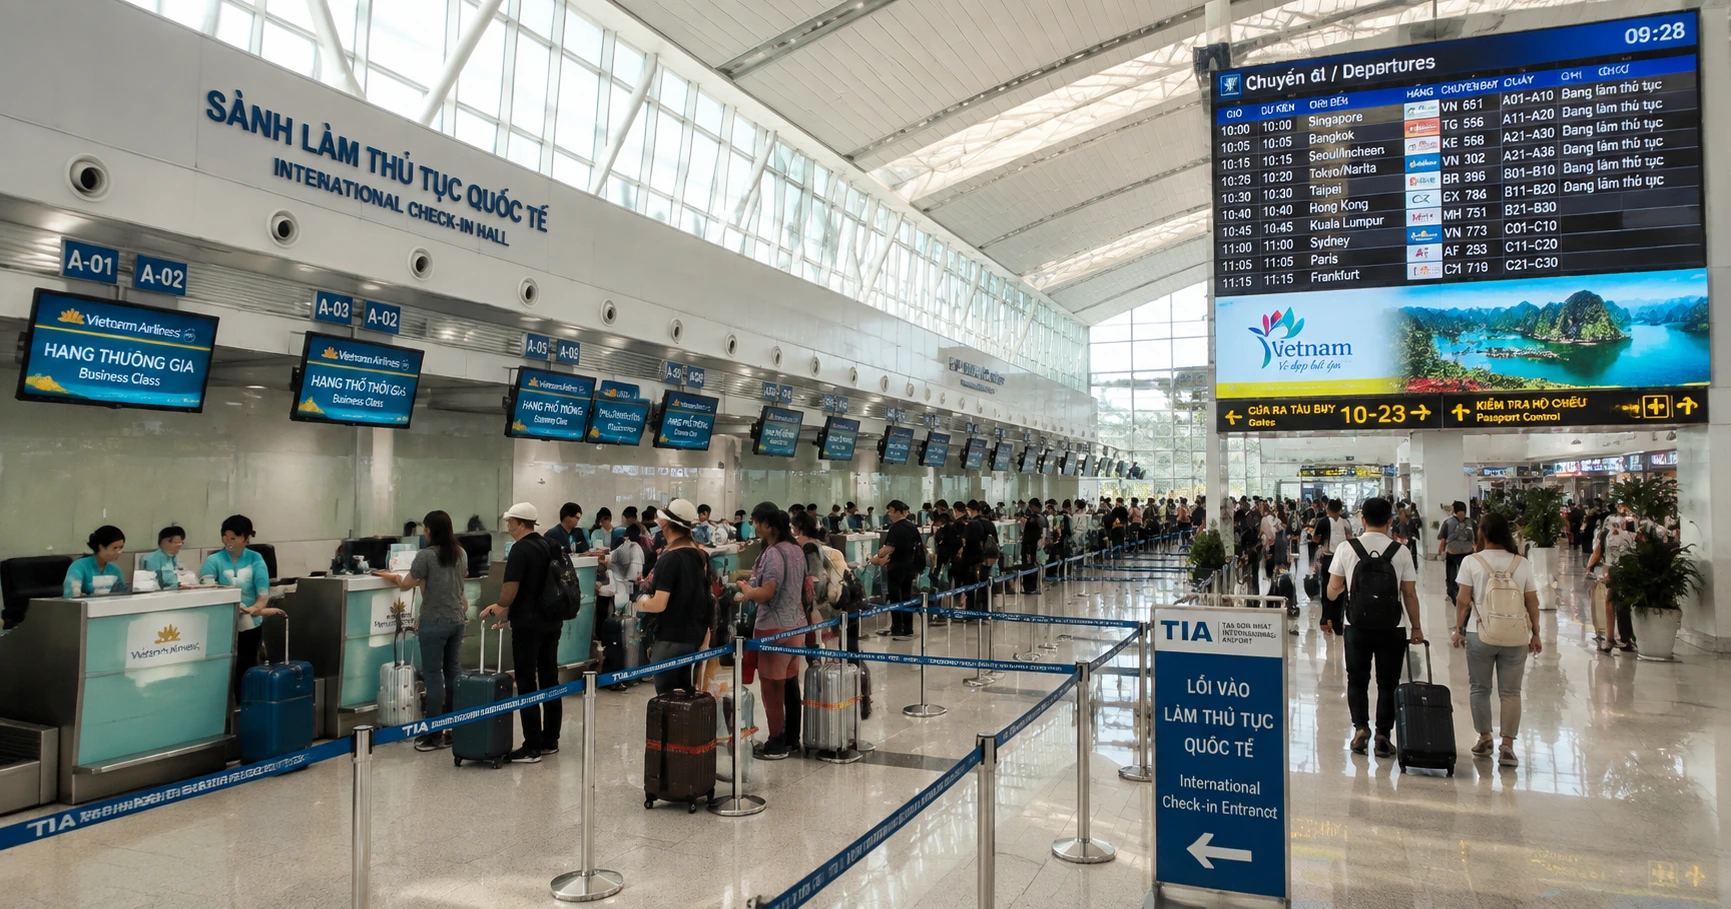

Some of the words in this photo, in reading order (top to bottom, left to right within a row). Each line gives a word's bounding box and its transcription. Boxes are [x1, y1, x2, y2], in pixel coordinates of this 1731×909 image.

[1625, 21, 1685, 44] 09:28
[1246, 68, 1305, 91] Chuyến
[1331, 65, 1338, 82] /
[1343, 58, 1436, 80] Departures
[1221, 124, 1250, 136] 10:00
[1262, 120, 1292, 132] 10:00
[1308, 113, 1363, 128] Singapore
[1441, 101, 1458, 112] VN
[1502, 90, 1554, 105] A01-A10
[1221, 140, 1250, 153] 10:05
[1263, 136, 1292, 149] 10:05
[1309, 130, 1355, 145] Bangkok
[1441, 119, 1458, 131] TG
[1503, 108, 1555, 125] A11-A20
[1263, 153, 1293, 167] 10:15
[1442, 137, 1458, 149] KE
[1503, 127, 1555, 143] A21-A30
[206, 89, 293, 146] SÀNH
[302, 122, 360, 168] LÀM
[366, 150, 414, 186] THỦ
[419, 165, 463, 203] TỤC
[467, 188, 524, 224] QUỐC
[527, 204, 550, 233] TẾ
[1263, 170, 1293, 184] 10:20
[1442, 155, 1459, 167] VN
[1464, 152, 1485, 165] 302
[1222, 191, 1252, 204] 10:30
[1263, 187, 1293, 200] 10:30
[1309, 183, 1342, 198] Taipei
[1443, 172, 1460, 185] BR
[1222, 208, 1252, 220] 10:40
[1263, 204, 1293, 217] 10:40
[1309, 202, 1338, 214] Hong
[1340, 199, 1369, 212] Kong
[1504, 183, 1556, 198] B11-B20
[407, 201, 475, 235] CHECK-IN
[476, 222, 510, 247] HALL
[1222, 225, 1252, 237] 10:45
[1310, 218, 1340, 231] Kuala
[1342, 216, 1385, 229] Lumpur
[1443, 208, 1462, 221] MH
[1466, 207, 1487, 218] 751
[1504, 201, 1557, 216] B21-B30
[1222, 242, 1252, 254] 11:00
[1264, 239, 1293, 251] 11:00
[1310, 236, 1350, 250] Sydney
[1444, 226, 1461, 238] VN
[1466, 225, 1487, 237] 773
[1505, 220, 1557, 235] C01-C10
[67, 249, 113, 276] A-01
[1222, 259, 1252, 272] 11:05
[1264, 256, 1294, 268] 11:05
[1310, 253, 1338, 266] Paris
[1444, 245, 1460, 257] AF
[1466, 243, 1488, 256] 293
[1505, 238, 1558, 253] C11-C20
[140, 264, 185, 289] A-02
[1222, 276, 1252, 289] 11:15
[1264, 273, 1294, 286] 11:15
[1311, 269, 1360, 283] Frankfurt
[1505, 256, 1559, 271] C21-C30
[318, 298, 350, 319] A-03
[367, 307, 398, 328] A-02
[44, 342, 95, 362] HANG
[169, 358, 195, 373] GIA
[1271, 340, 1353, 358] Vietnam
[78, 367, 129, 384] Business
[131, 372, 161, 387] Class
[310, 374, 343, 389] HANG
[1272, 405, 1288, 415] RA
[1340, 404, 1406, 424] 10-23
[1160, 620, 1213, 643] TIA
[1217, 676, 1250, 698] VÀO
[401, 721, 429, 737] TIA
[1164, 704, 1198, 724] LÀM
[1202, 706, 1235, 727] THỦ
[1240, 712, 1274, 732] TỤC
[1180, 774, 1261, 795] International
[1162, 794, 1218, 814] Check-in
[26, 813, 77, 837] TIA
